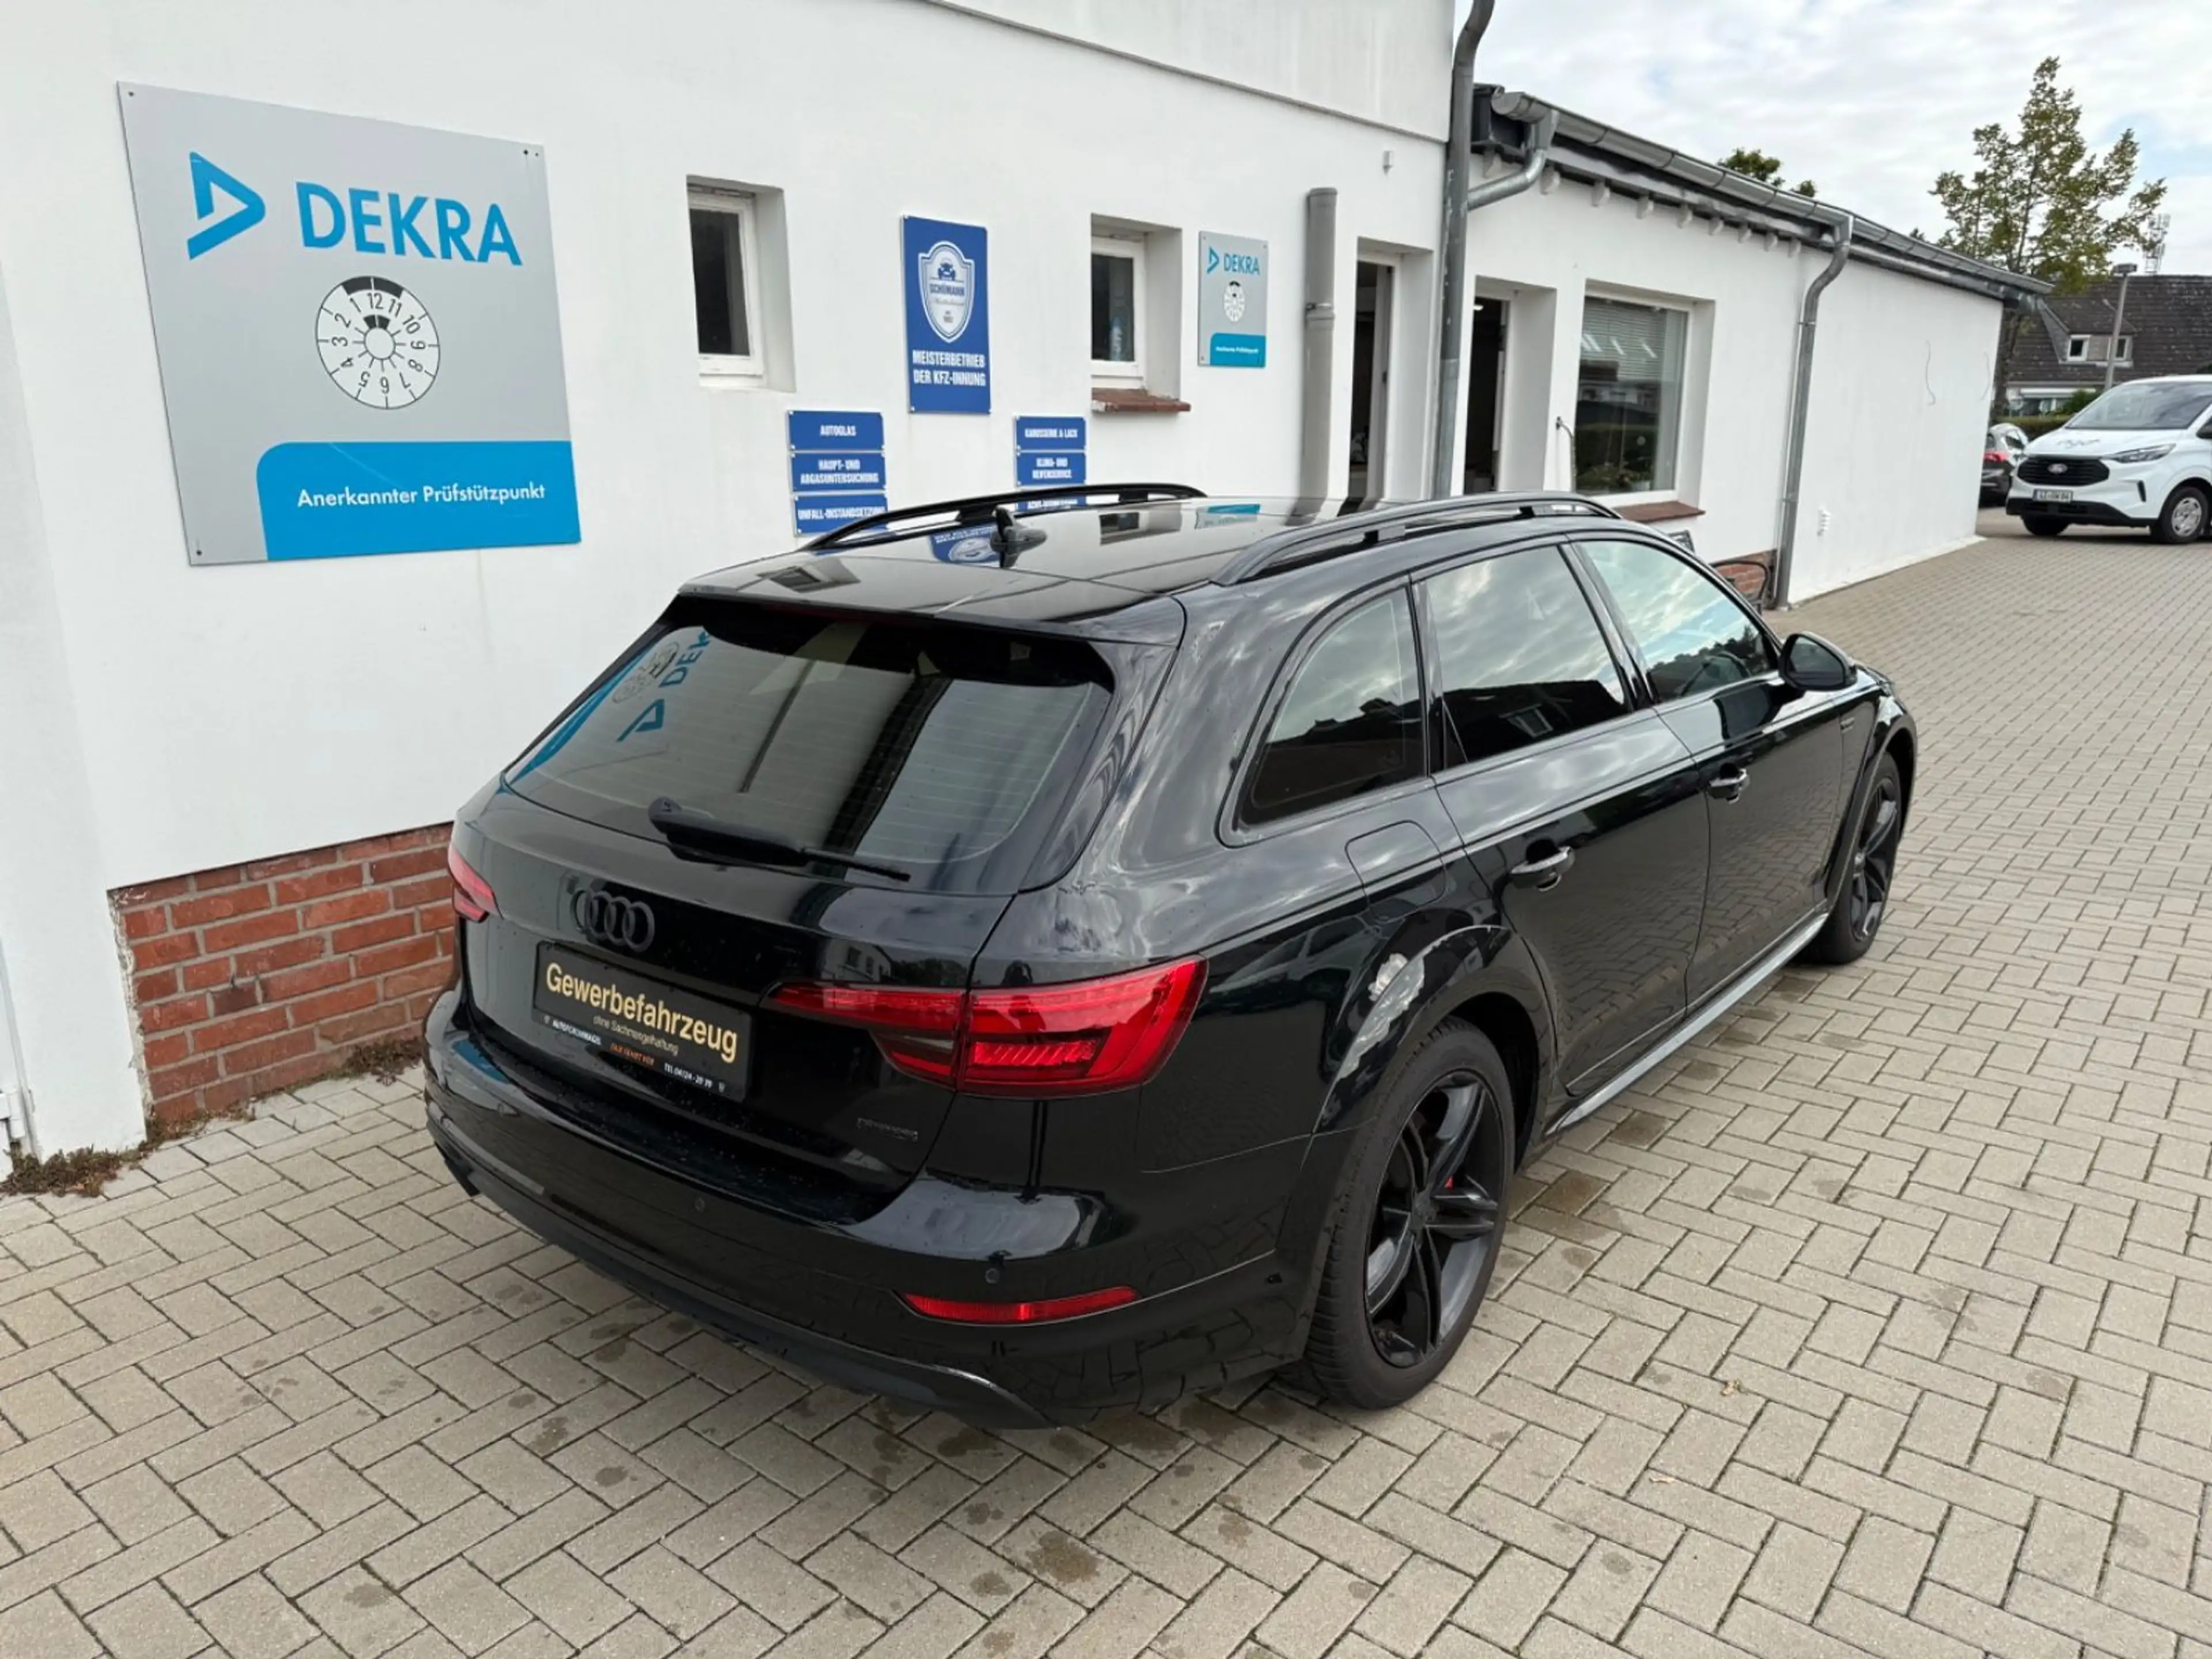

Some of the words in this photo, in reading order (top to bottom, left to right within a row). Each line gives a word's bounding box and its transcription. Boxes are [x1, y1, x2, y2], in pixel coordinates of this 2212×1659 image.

[296, 181, 523, 266] DEKRA
[1224, 252, 1260, 275] DEKRA
[350, 297, 361, 312] 1
[368, 293, 384, 309] 12
[388, 298, 402, 317] 11
[334, 313, 351, 328] 2
[403, 315, 421, 334] 10
[332, 336, 348, 346] 3
[411, 340, 426, 350] 9
[340, 358, 354, 368] 4
[408, 359, 423, 372] 8
[912, 350, 985, 368] MEISTERBETRIEB
[358, 371, 370, 388] 5
[380, 377, 389, 393] 6
[400, 372, 411, 388] 7
[913, 369, 931, 384] DER
[933, 370, 986, 387] KFZ-INNUNG
[820, 425, 857, 437] AUTOGLAS
[845, 459, 861, 471] UND
[297, 487, 418, 507] Anerkannter
[424, 483, 545, 504] Prüfstützpunkt
[546, 962, 737, 1063] Gewerbefahrzeug
